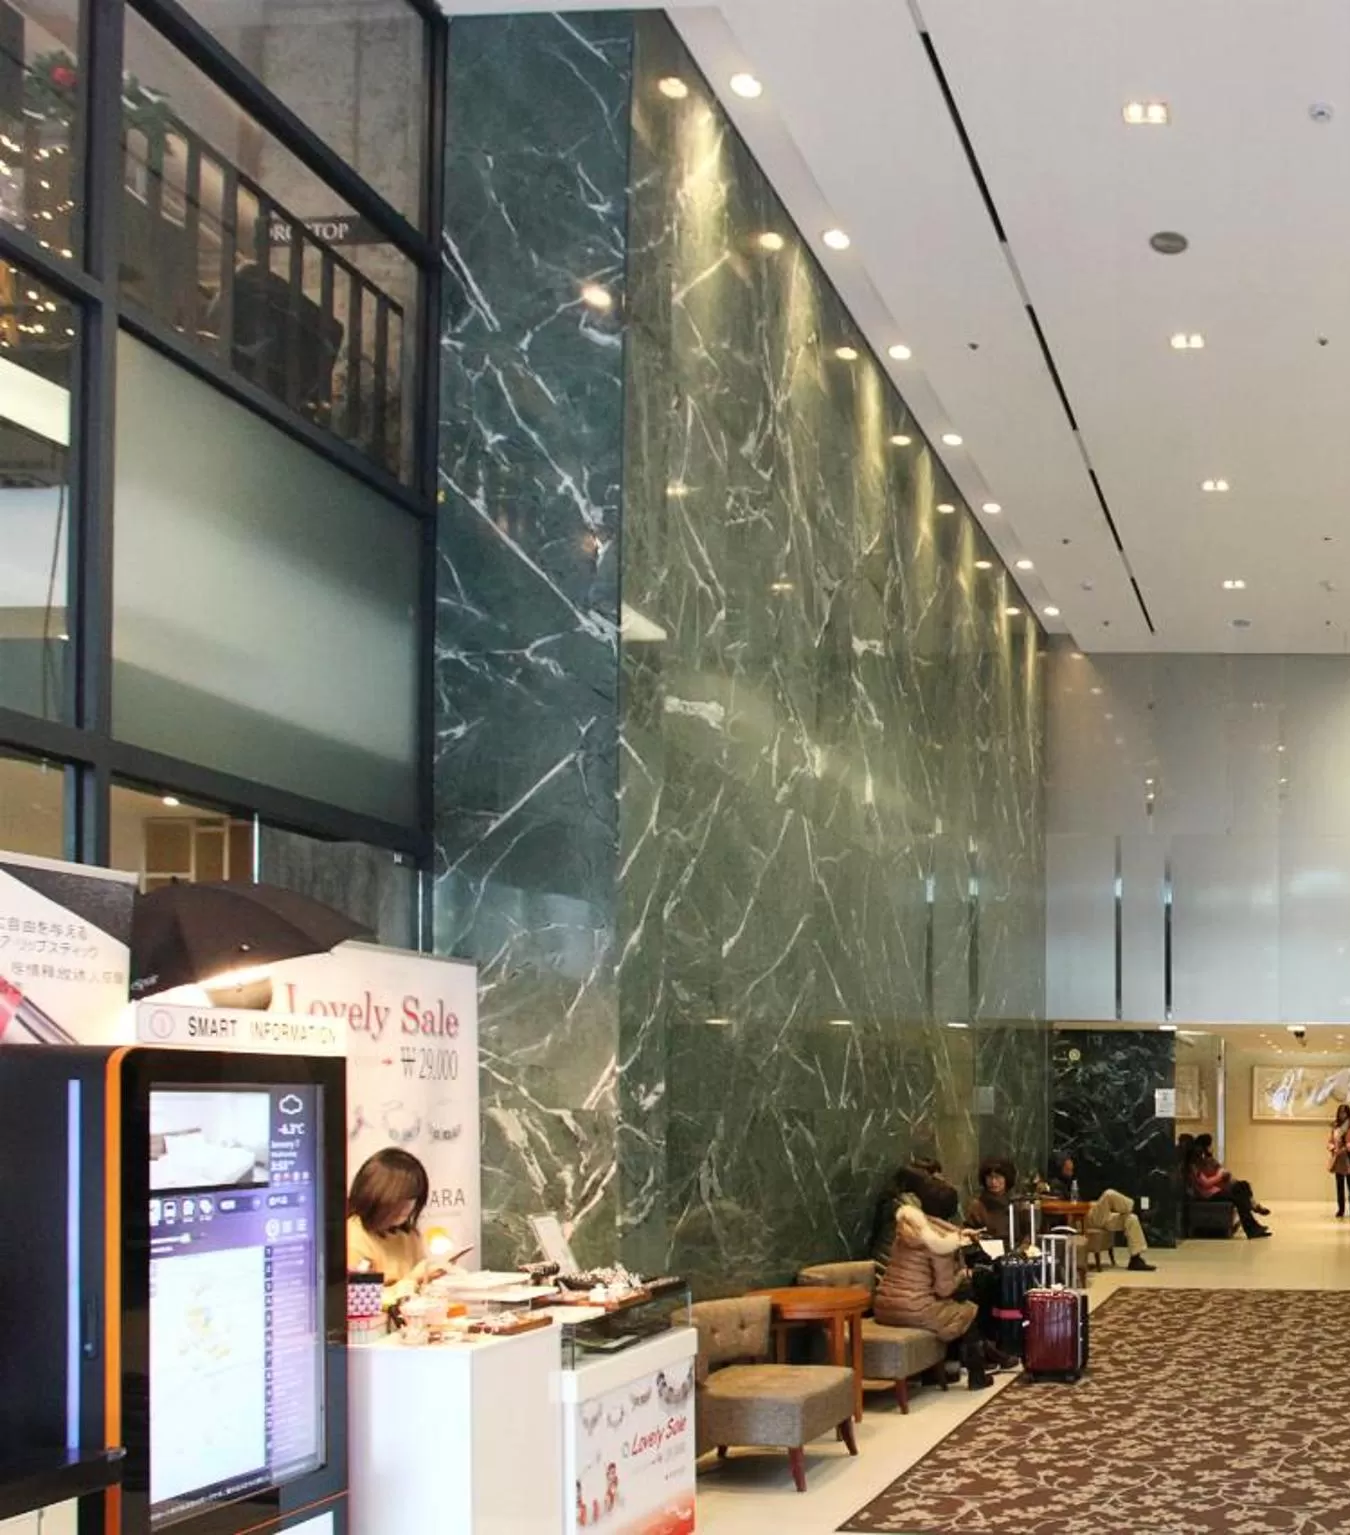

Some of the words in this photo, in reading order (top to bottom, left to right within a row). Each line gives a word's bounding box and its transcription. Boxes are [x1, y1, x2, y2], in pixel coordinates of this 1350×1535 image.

[188, 1016, 238, 1037] SMART
[401, 994, 460, 1040] Sale
[430, 1187, 466, 1208] ARA
